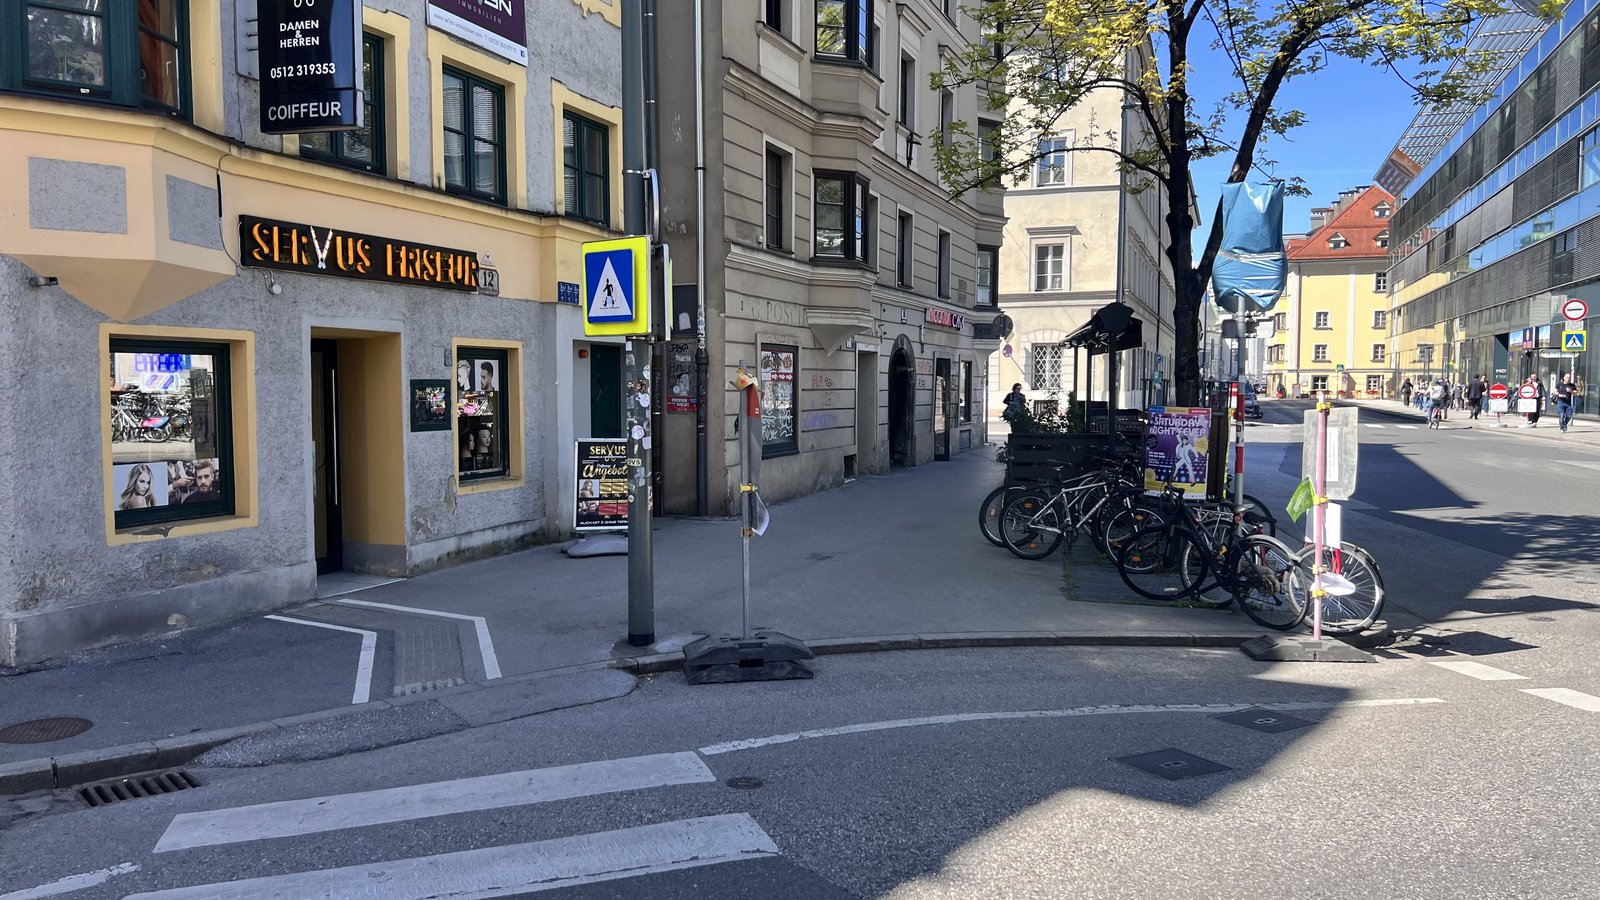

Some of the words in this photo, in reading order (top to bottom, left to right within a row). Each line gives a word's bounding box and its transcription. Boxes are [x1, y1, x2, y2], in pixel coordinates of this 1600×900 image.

[458, 0, 502, 25] IMMOBILIEN
[280, 20, 319, 32] DAMEN
[295, 30, 302, 38] &
[280, 37, 320, 48] HERREN
[270, 66, 294, 79] 0512
[297, 62, 336, 76] 319353
[268, 101, 342, 121] COIFFEUR
[252, 223, 373, 273] SERVUS
[385, 243, 480, 287] FRISEUR
[483, 270, 494, 287] 12
[1154, 416, 1200, 428] SATURDAY
[1150, 425, 1176, 435] NIGHT
[1178, 427, 1206, 436] FEVER
[590, 445, 626, 456] SERVUS
